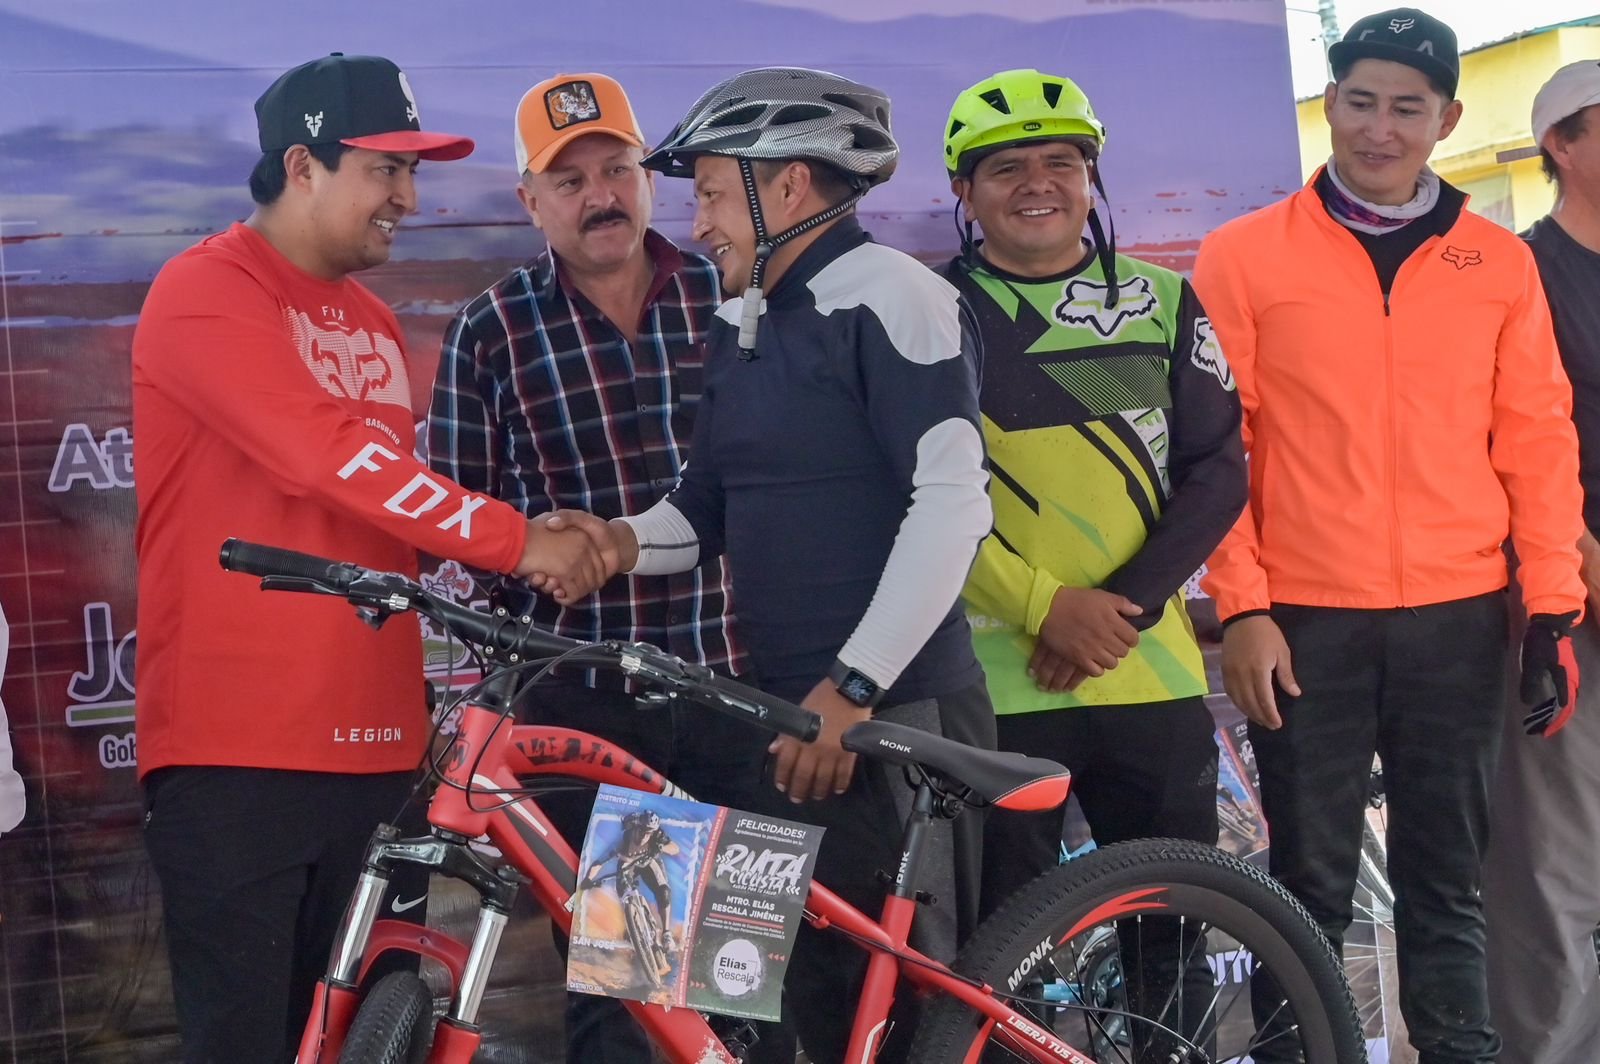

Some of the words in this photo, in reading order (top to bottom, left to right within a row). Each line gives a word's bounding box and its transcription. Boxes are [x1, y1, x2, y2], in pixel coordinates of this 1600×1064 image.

[336, 441, 487, 540] FOX
[333, 727, 401, 742] LEGION
[879, 739, 912, 753] MONK
[599, 794, 627, 804] DISTRITO
[736, 819, 807, 839] ¡FELICIDADES!
[716, 844, 809, 888] RUTA
[726, 895, 751, 907] MTRO.
[752, 900, 776, 911] ELÍAS
[711, 903, 748, 917] RESCALA
[749, 910, 785, 923] JIMÉNEZ
[572, 935, 591, 947] SAN
[1007, 935, 1054, 992] MONK
[716, 967, 755, 984] Rescala
[1007, 1015, 1047, 1045] LIBERA
[1047, 1041, 1072, 1059] TUS
